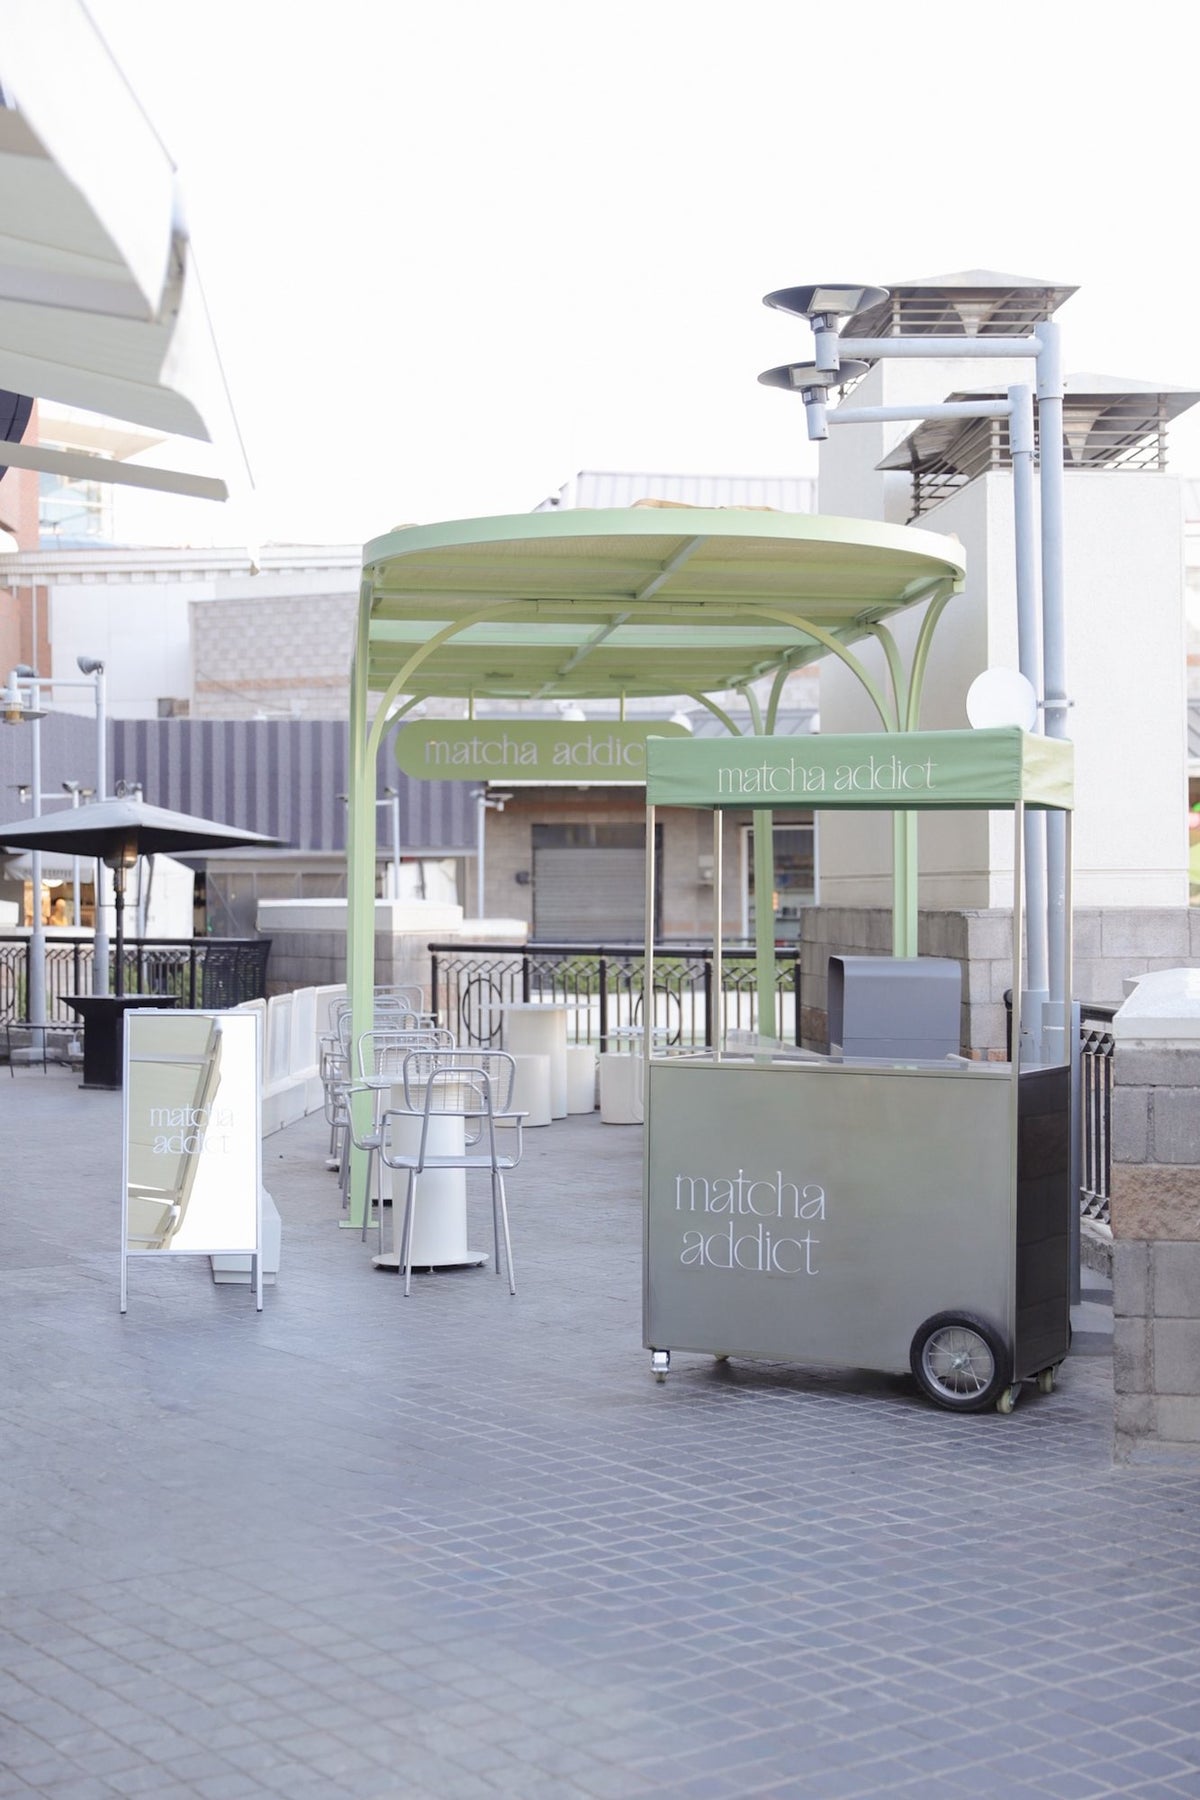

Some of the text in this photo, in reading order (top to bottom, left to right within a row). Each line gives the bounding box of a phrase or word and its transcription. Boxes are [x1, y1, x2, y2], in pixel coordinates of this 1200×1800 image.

[424, 733, 647, 767] matcha addic
[718, 755, 938, 793] matcha addict
[150, 1102, 233, 1127] matcha
[152, 1128, 230, 1154] addict
[675, 1168, 826, 1220] matcha
[680, 1221, 820, 1275] addict
